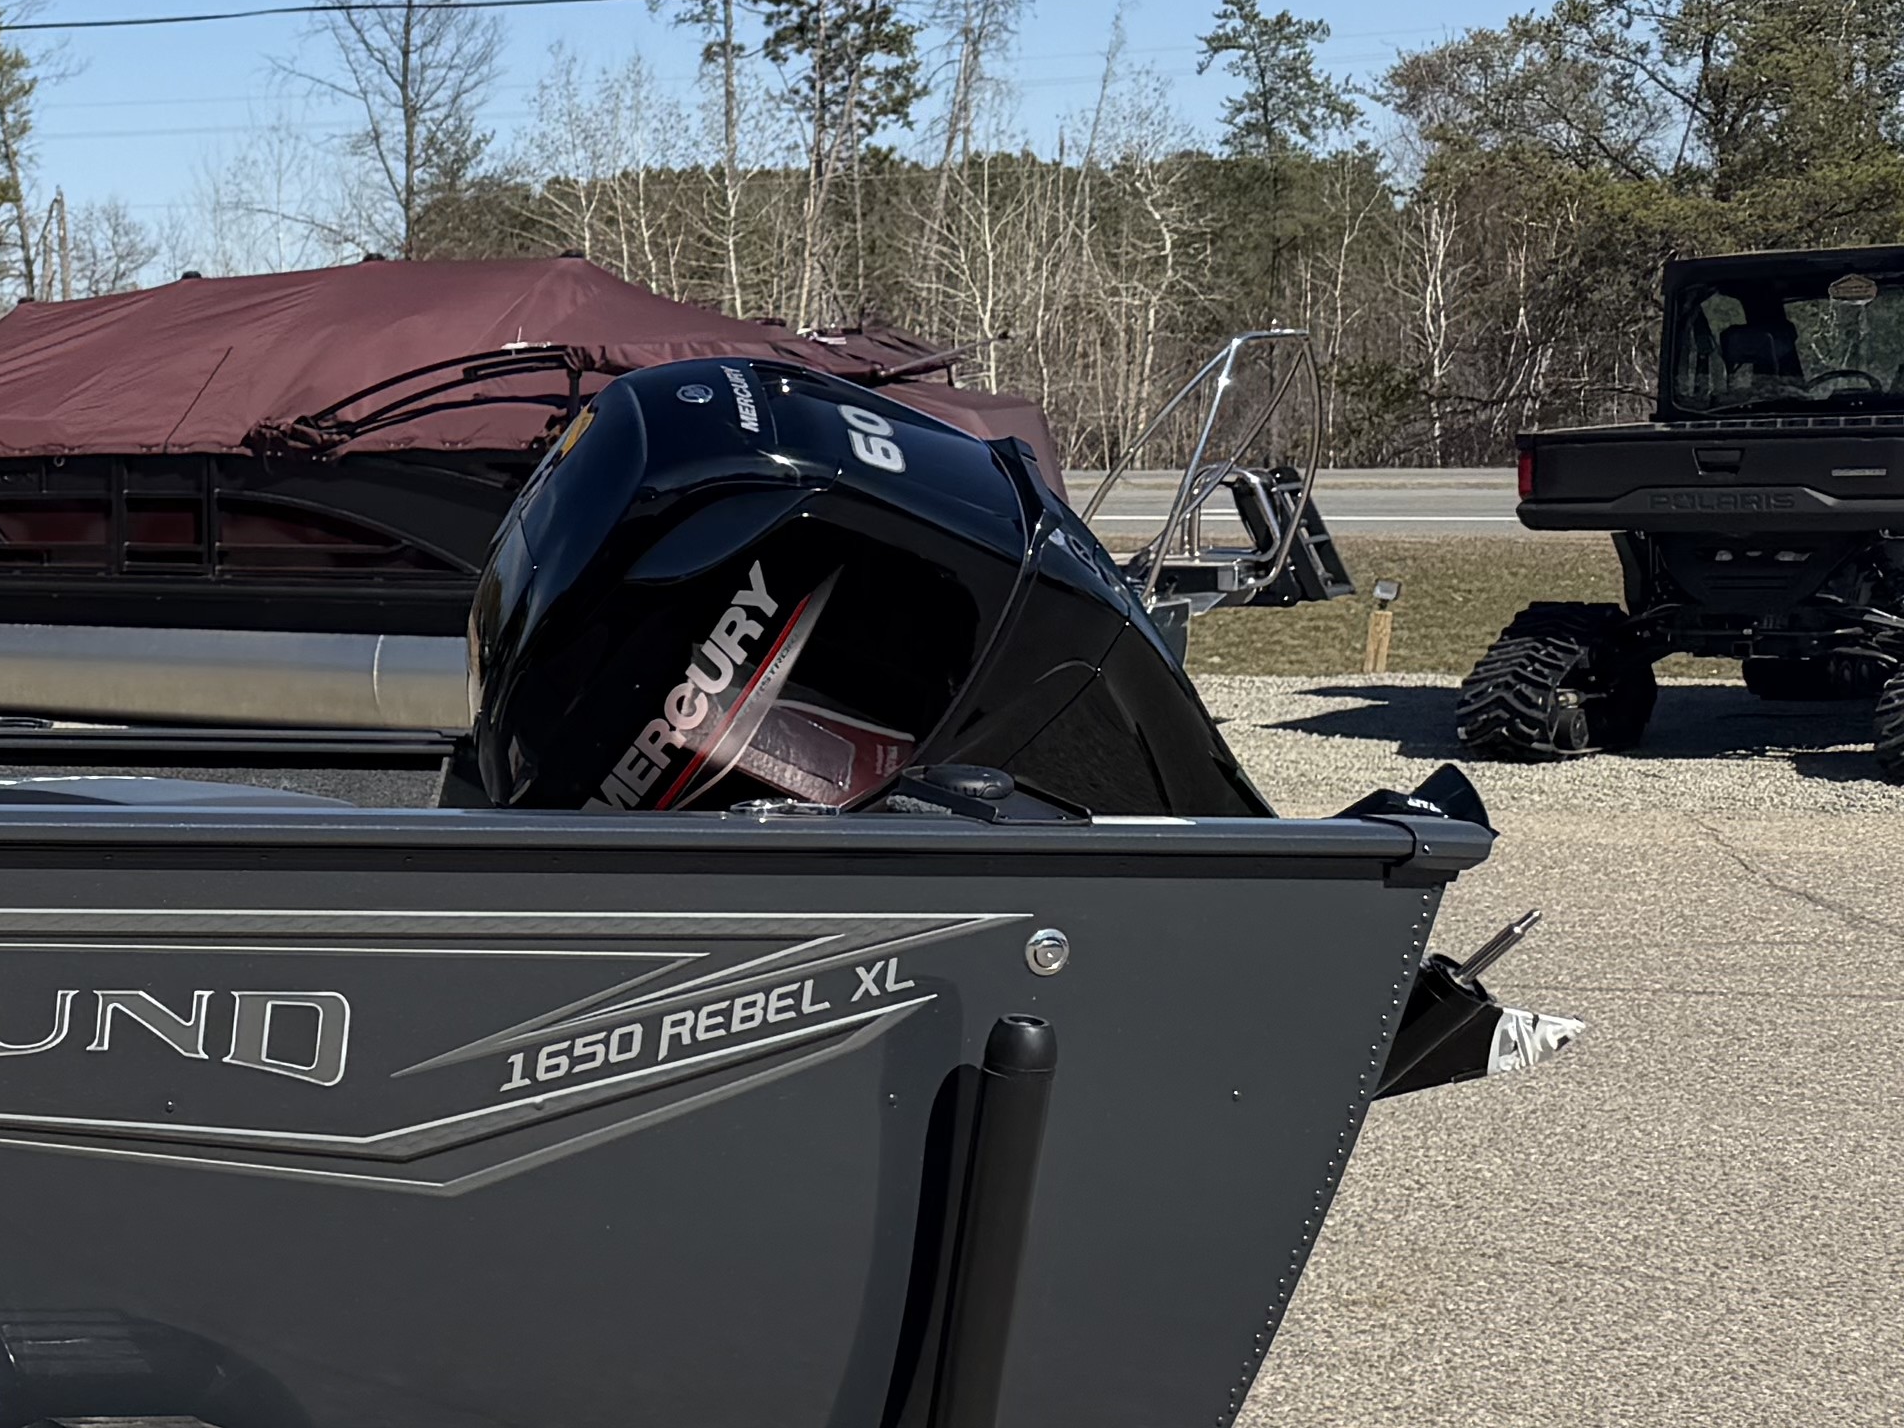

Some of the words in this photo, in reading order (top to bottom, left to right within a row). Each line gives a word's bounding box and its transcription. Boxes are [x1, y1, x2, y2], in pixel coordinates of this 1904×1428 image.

[720, 365, 760, 433] MERCURY
[837, 404, 907, 473] 60
[1648, 491, 1796, 511] POLARIS
[580, 559, 780, 812] MERCURY
[499, 1022, 644, 1093] 1650
[657, 978, 832, 1062] REBEL
[850, 956, 916, 1003] XL
